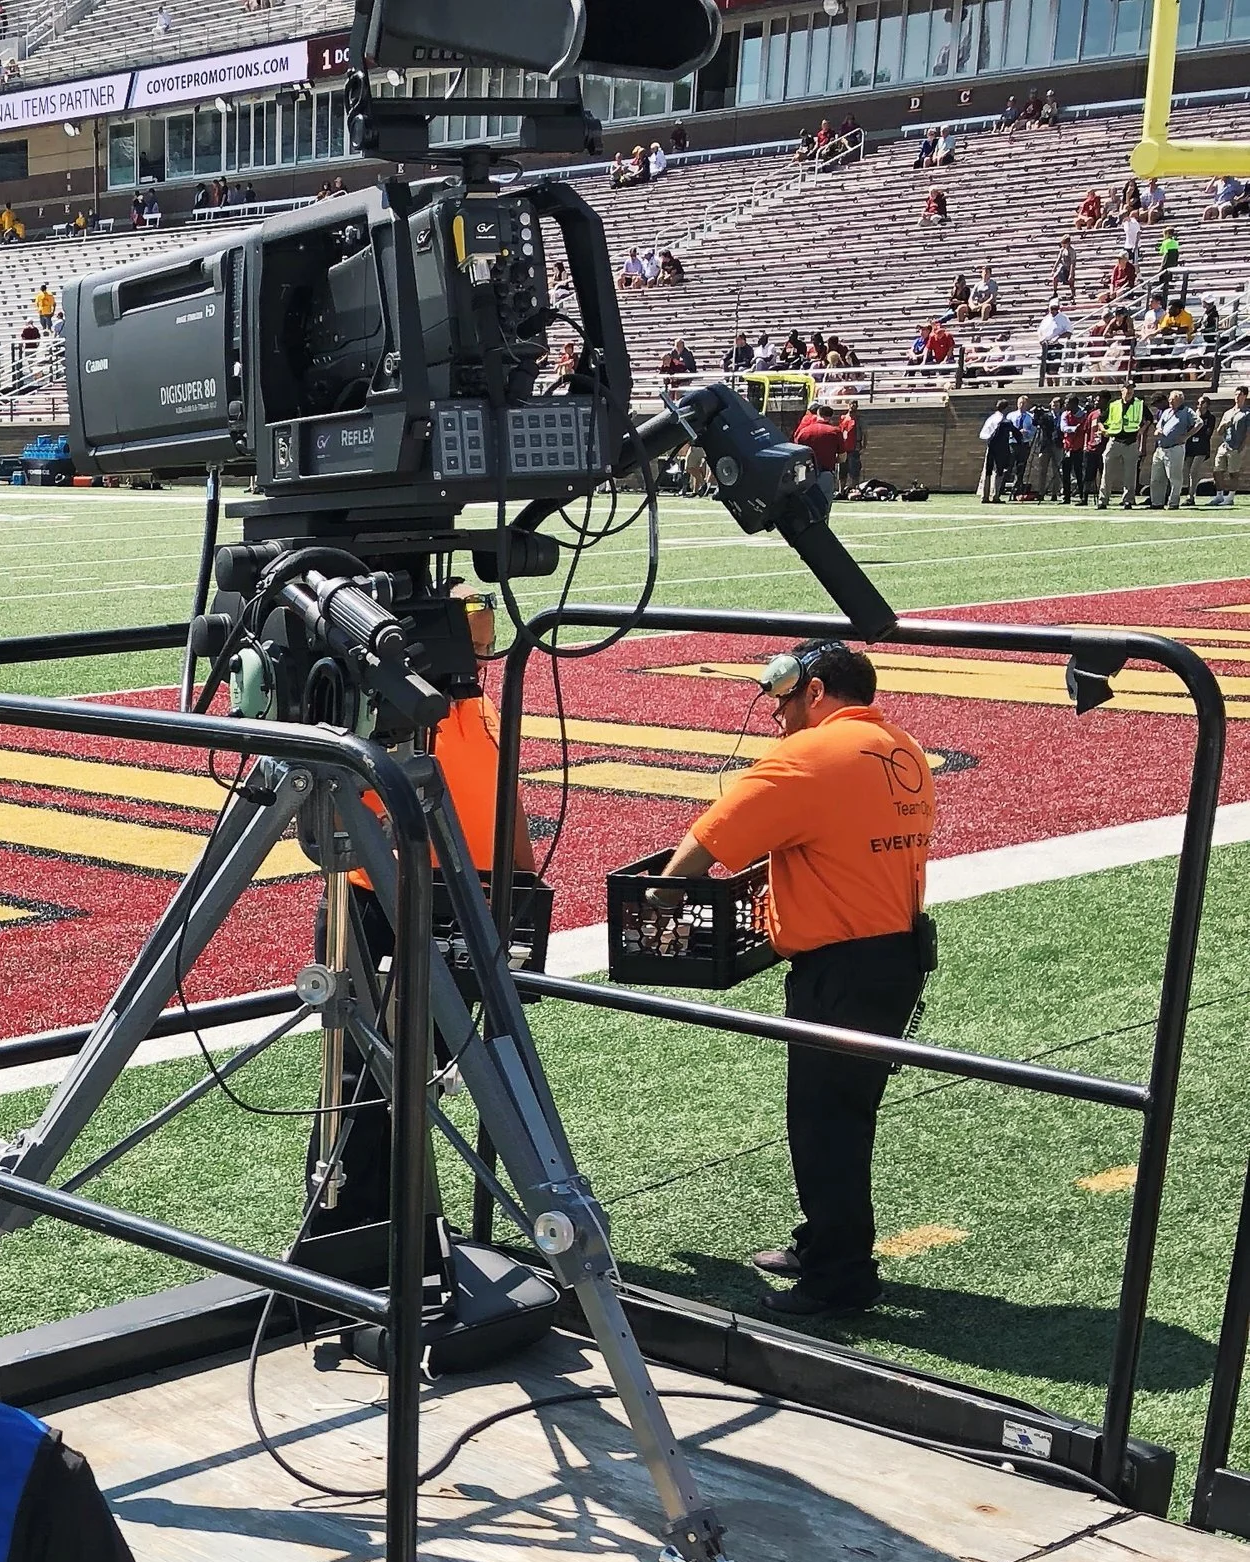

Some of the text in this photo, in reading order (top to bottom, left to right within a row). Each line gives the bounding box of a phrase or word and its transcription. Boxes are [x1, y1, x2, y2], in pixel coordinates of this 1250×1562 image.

[322, 48, 332, 70] 1
[146, 56, 290, 95] COYOTEPROMOTIONS.COM
[21, 94, 57, 120] ITEMS
[59, 84, 116, 113] PARTNER
[85, 358, 109, 374] Canon
[160, 378, 216, 405] DIGISUPER 80
[341, 427, 375, 447] REFLEX
